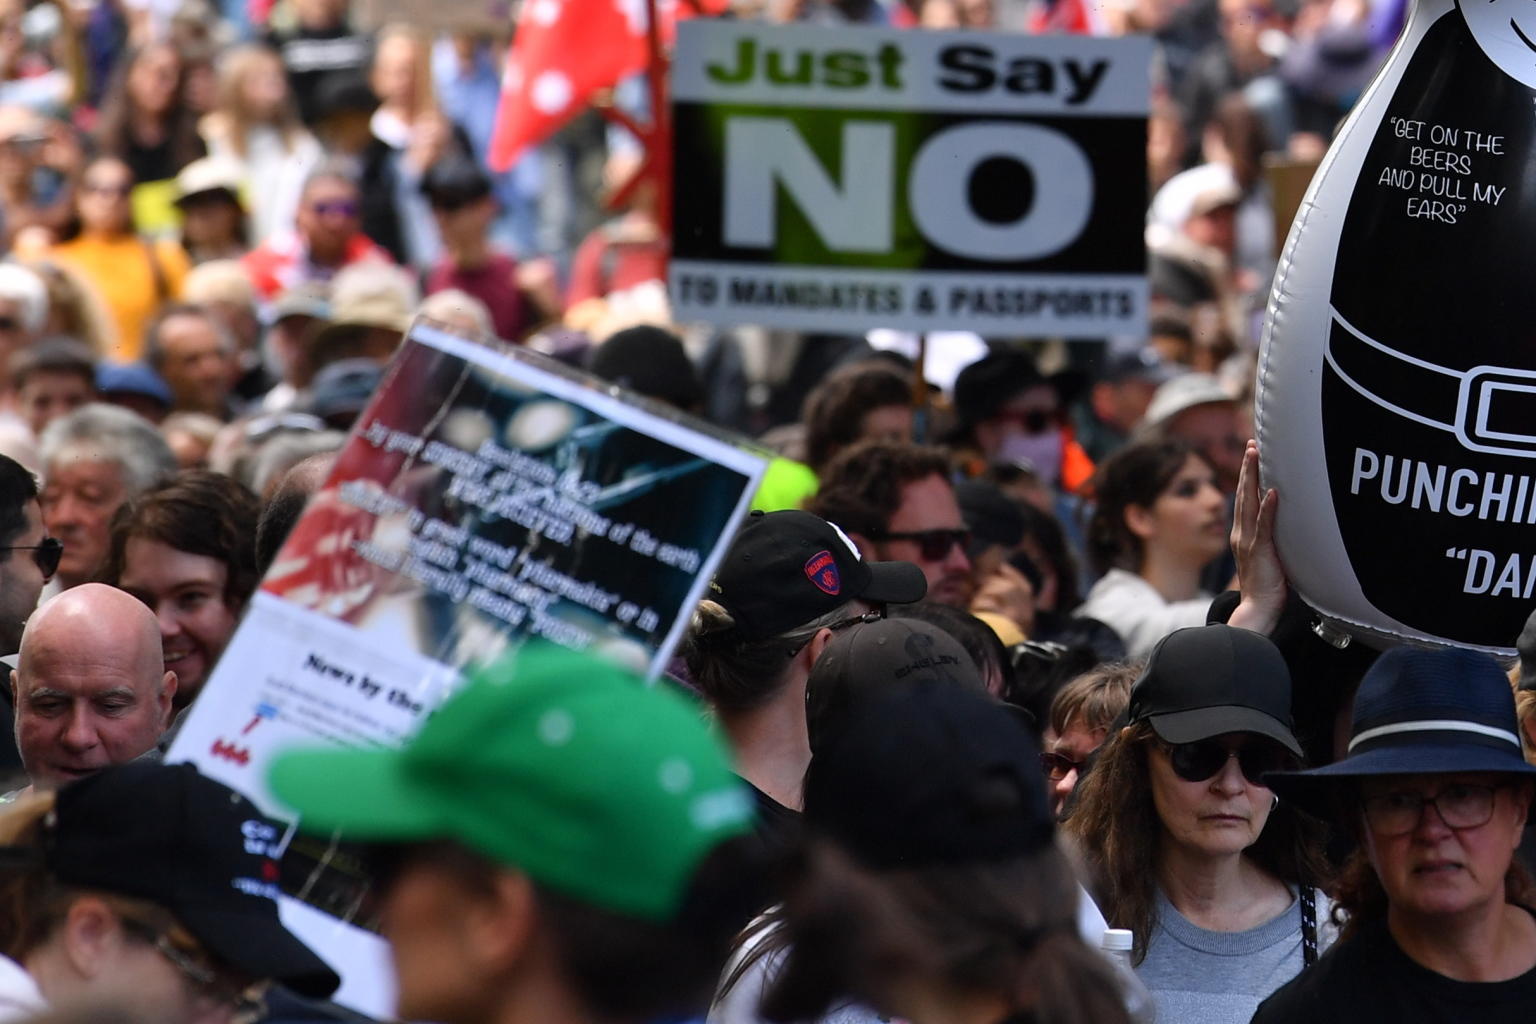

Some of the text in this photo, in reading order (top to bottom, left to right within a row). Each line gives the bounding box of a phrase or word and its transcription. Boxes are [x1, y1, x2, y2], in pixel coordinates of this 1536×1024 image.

[707, 38, 1112, 107] Just Say
[1410, 146, 1471, 175] BEERS
[1431, 125, 1459, 147] ON
[1464, 131, 1505, 155] THE
[722, 115, 1095, 263] NO
[1379, 167, 1506, 206] AND PULL MY
[679, 277, 1135, 321] TO MANDATES & PASSPORTS
[608, 523, 634, 545] of
[629, 528, 660, 557] the
[655, 542, 700, 575] earth
[357, 673, 382, 700] by
